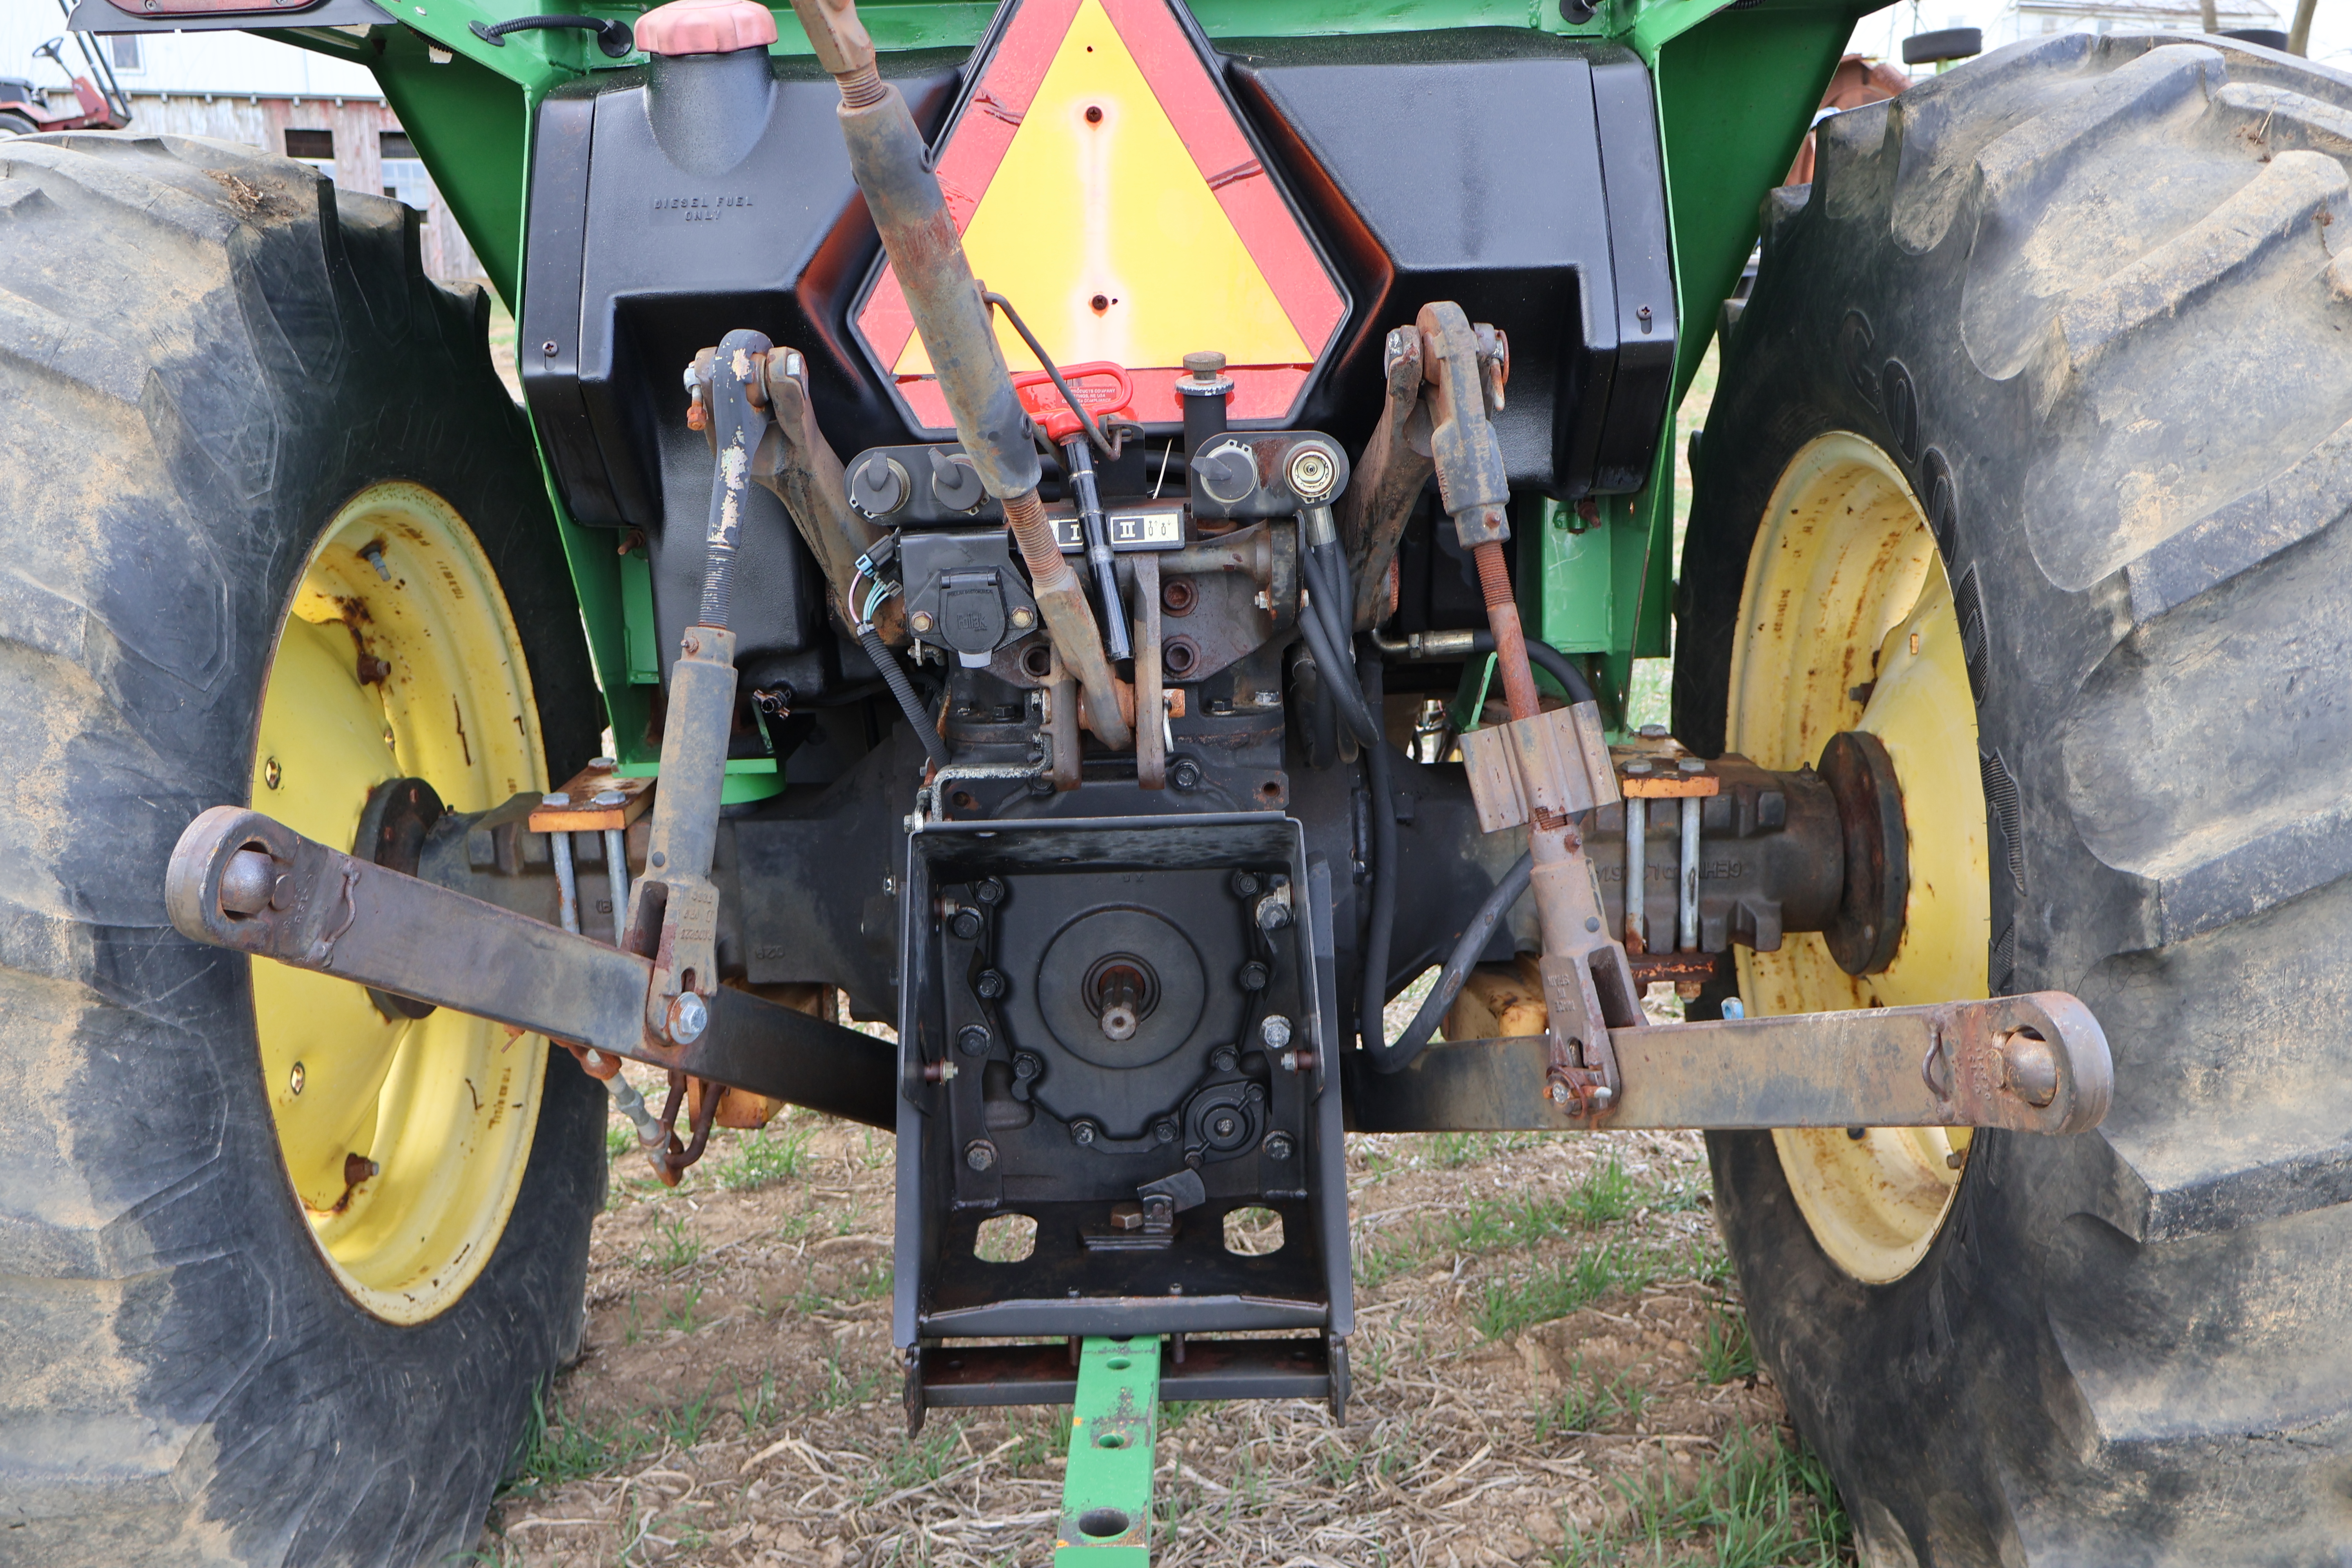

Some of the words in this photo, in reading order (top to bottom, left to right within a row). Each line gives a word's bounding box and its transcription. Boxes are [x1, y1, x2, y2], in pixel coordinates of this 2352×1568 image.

[654, 197, 709, 209] DIESEL
[716, 196, 754, 207] FUEL
[684, 210, 721, 221] ONLY
[957, 612, 987, 630] Pollak
